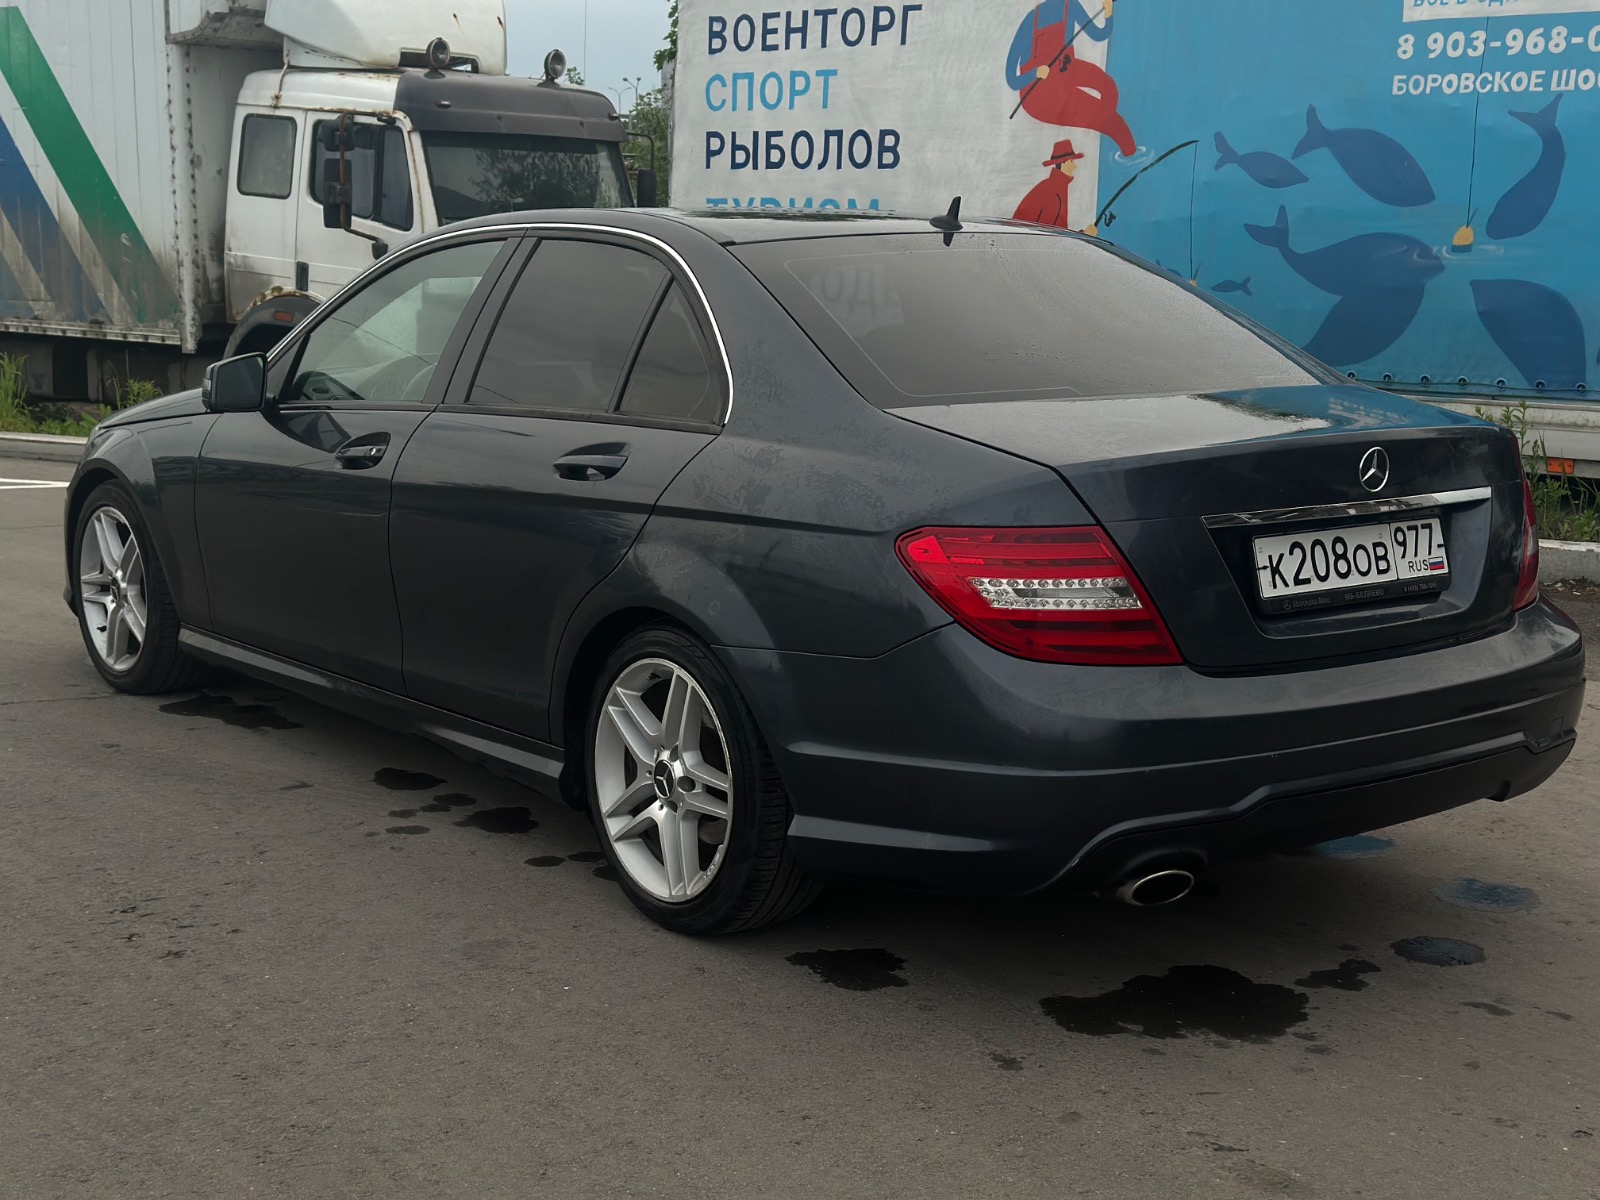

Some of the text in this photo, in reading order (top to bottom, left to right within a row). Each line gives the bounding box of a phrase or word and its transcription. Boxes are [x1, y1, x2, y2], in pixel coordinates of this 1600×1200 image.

[707, 3, 923, 55] ВОЕНТОРГ
[1396, 33, 1415, 60] 8
[705, 68, 838, 112] СПОРТ
[1391, 68, 1600, 95] БОРОВСКОЕ ШО
[705, 128, 901, 171] РЫБОЛОВ
[1267, 522, 1433, 590] К208ОВ 977
[1407, 558, 1429, 573] RUS
